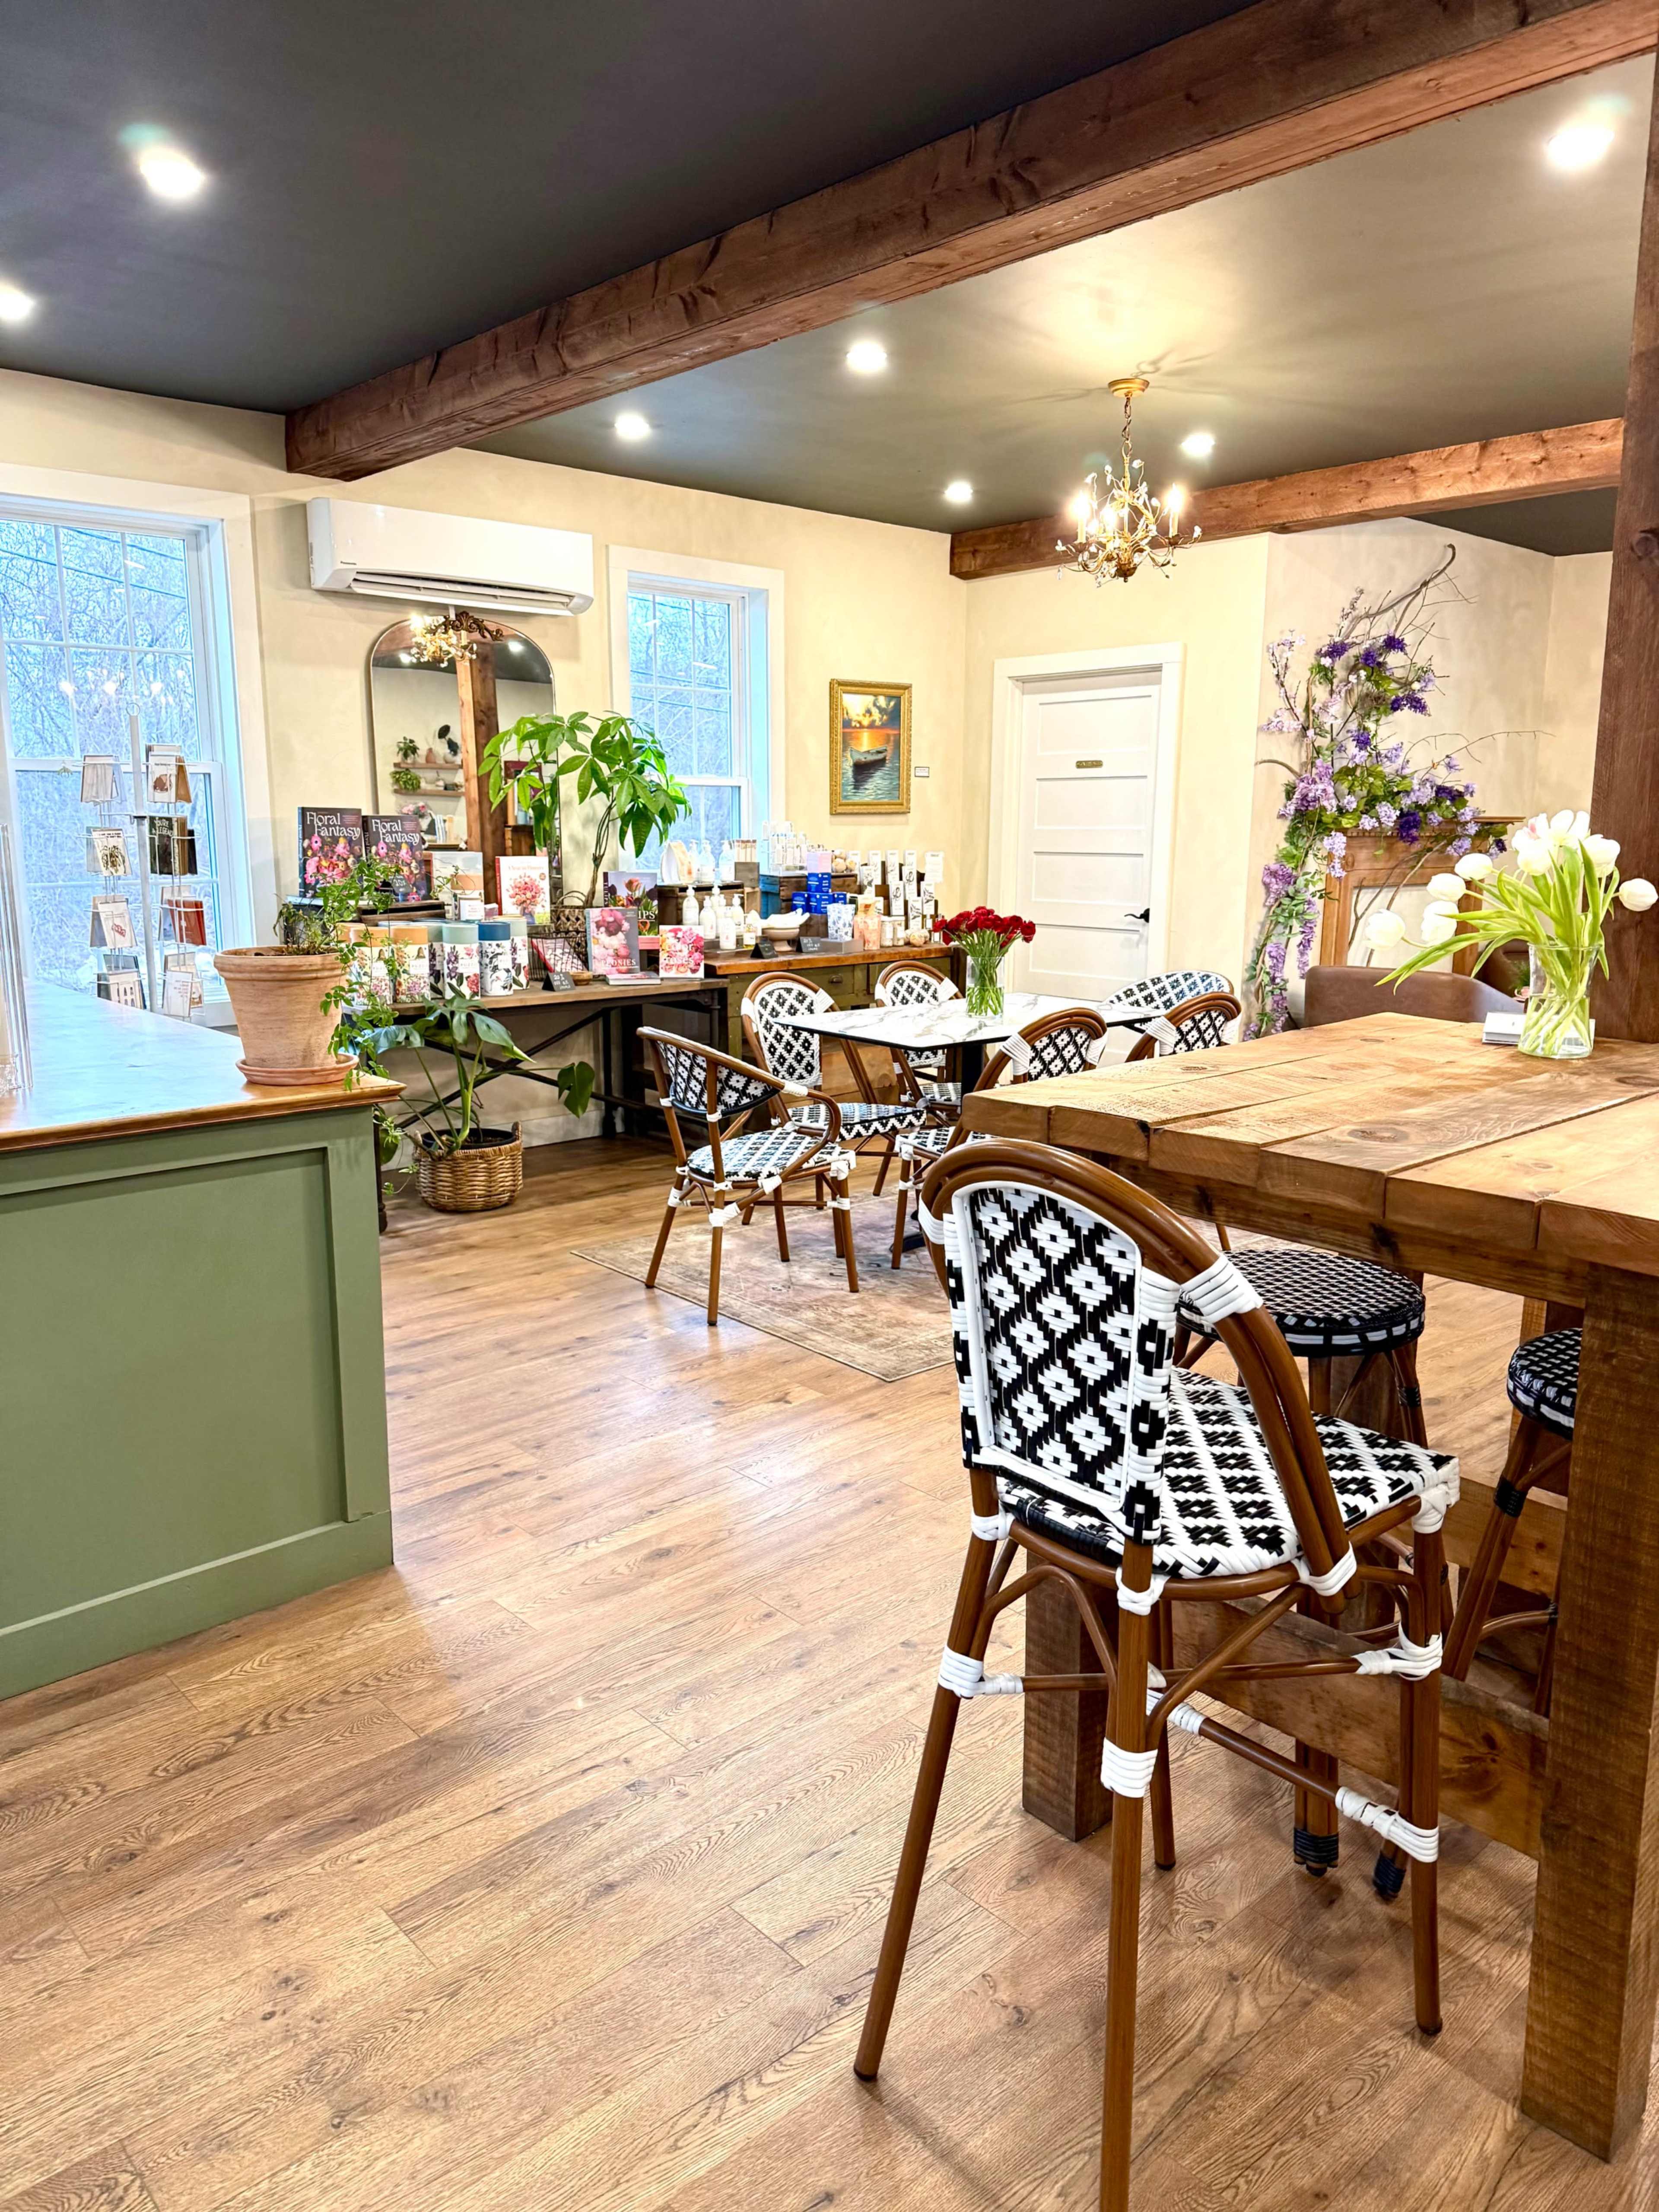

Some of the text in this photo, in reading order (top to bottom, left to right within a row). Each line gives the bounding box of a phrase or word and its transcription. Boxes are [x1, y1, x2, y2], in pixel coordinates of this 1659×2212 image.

[306, 812, 340, 825] Floral
[315, 824, 360, 840] Fantasy
[372, 819, 402, 833] Floral
[379, 830, 420, 846] Fantasy
[638, 910, 655, 919] IPS
[601, 959, 636, 967] PEONIES
